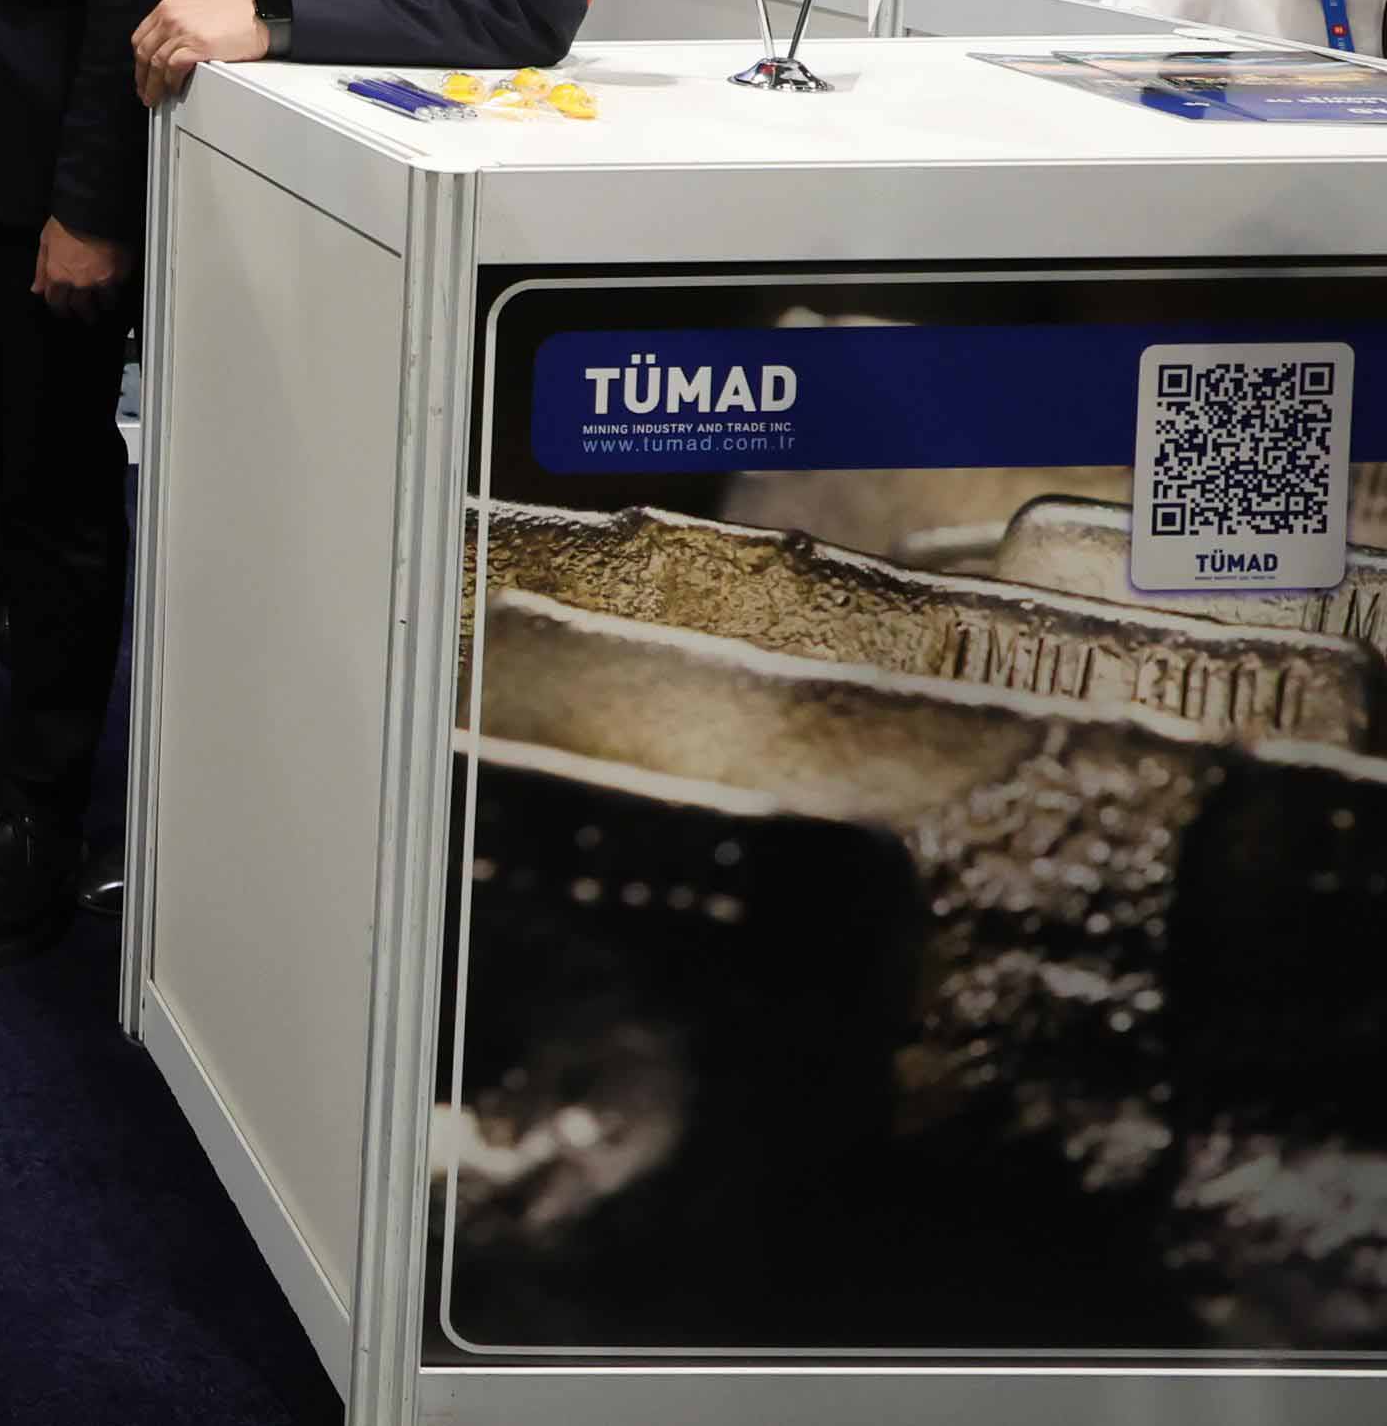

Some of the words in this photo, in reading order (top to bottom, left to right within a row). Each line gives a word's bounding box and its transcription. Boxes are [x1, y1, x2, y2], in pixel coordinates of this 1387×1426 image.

[585, 353, 798, 415] TÜMAD
[582, 424, 628, 436] MINING
[632, 423, 693, 435] INDUSTRY
[696, 422, 723, 434] AND
[727, 422, 767, 434] TRADE
[1195, 549, 1278, 573] TÜMAD
